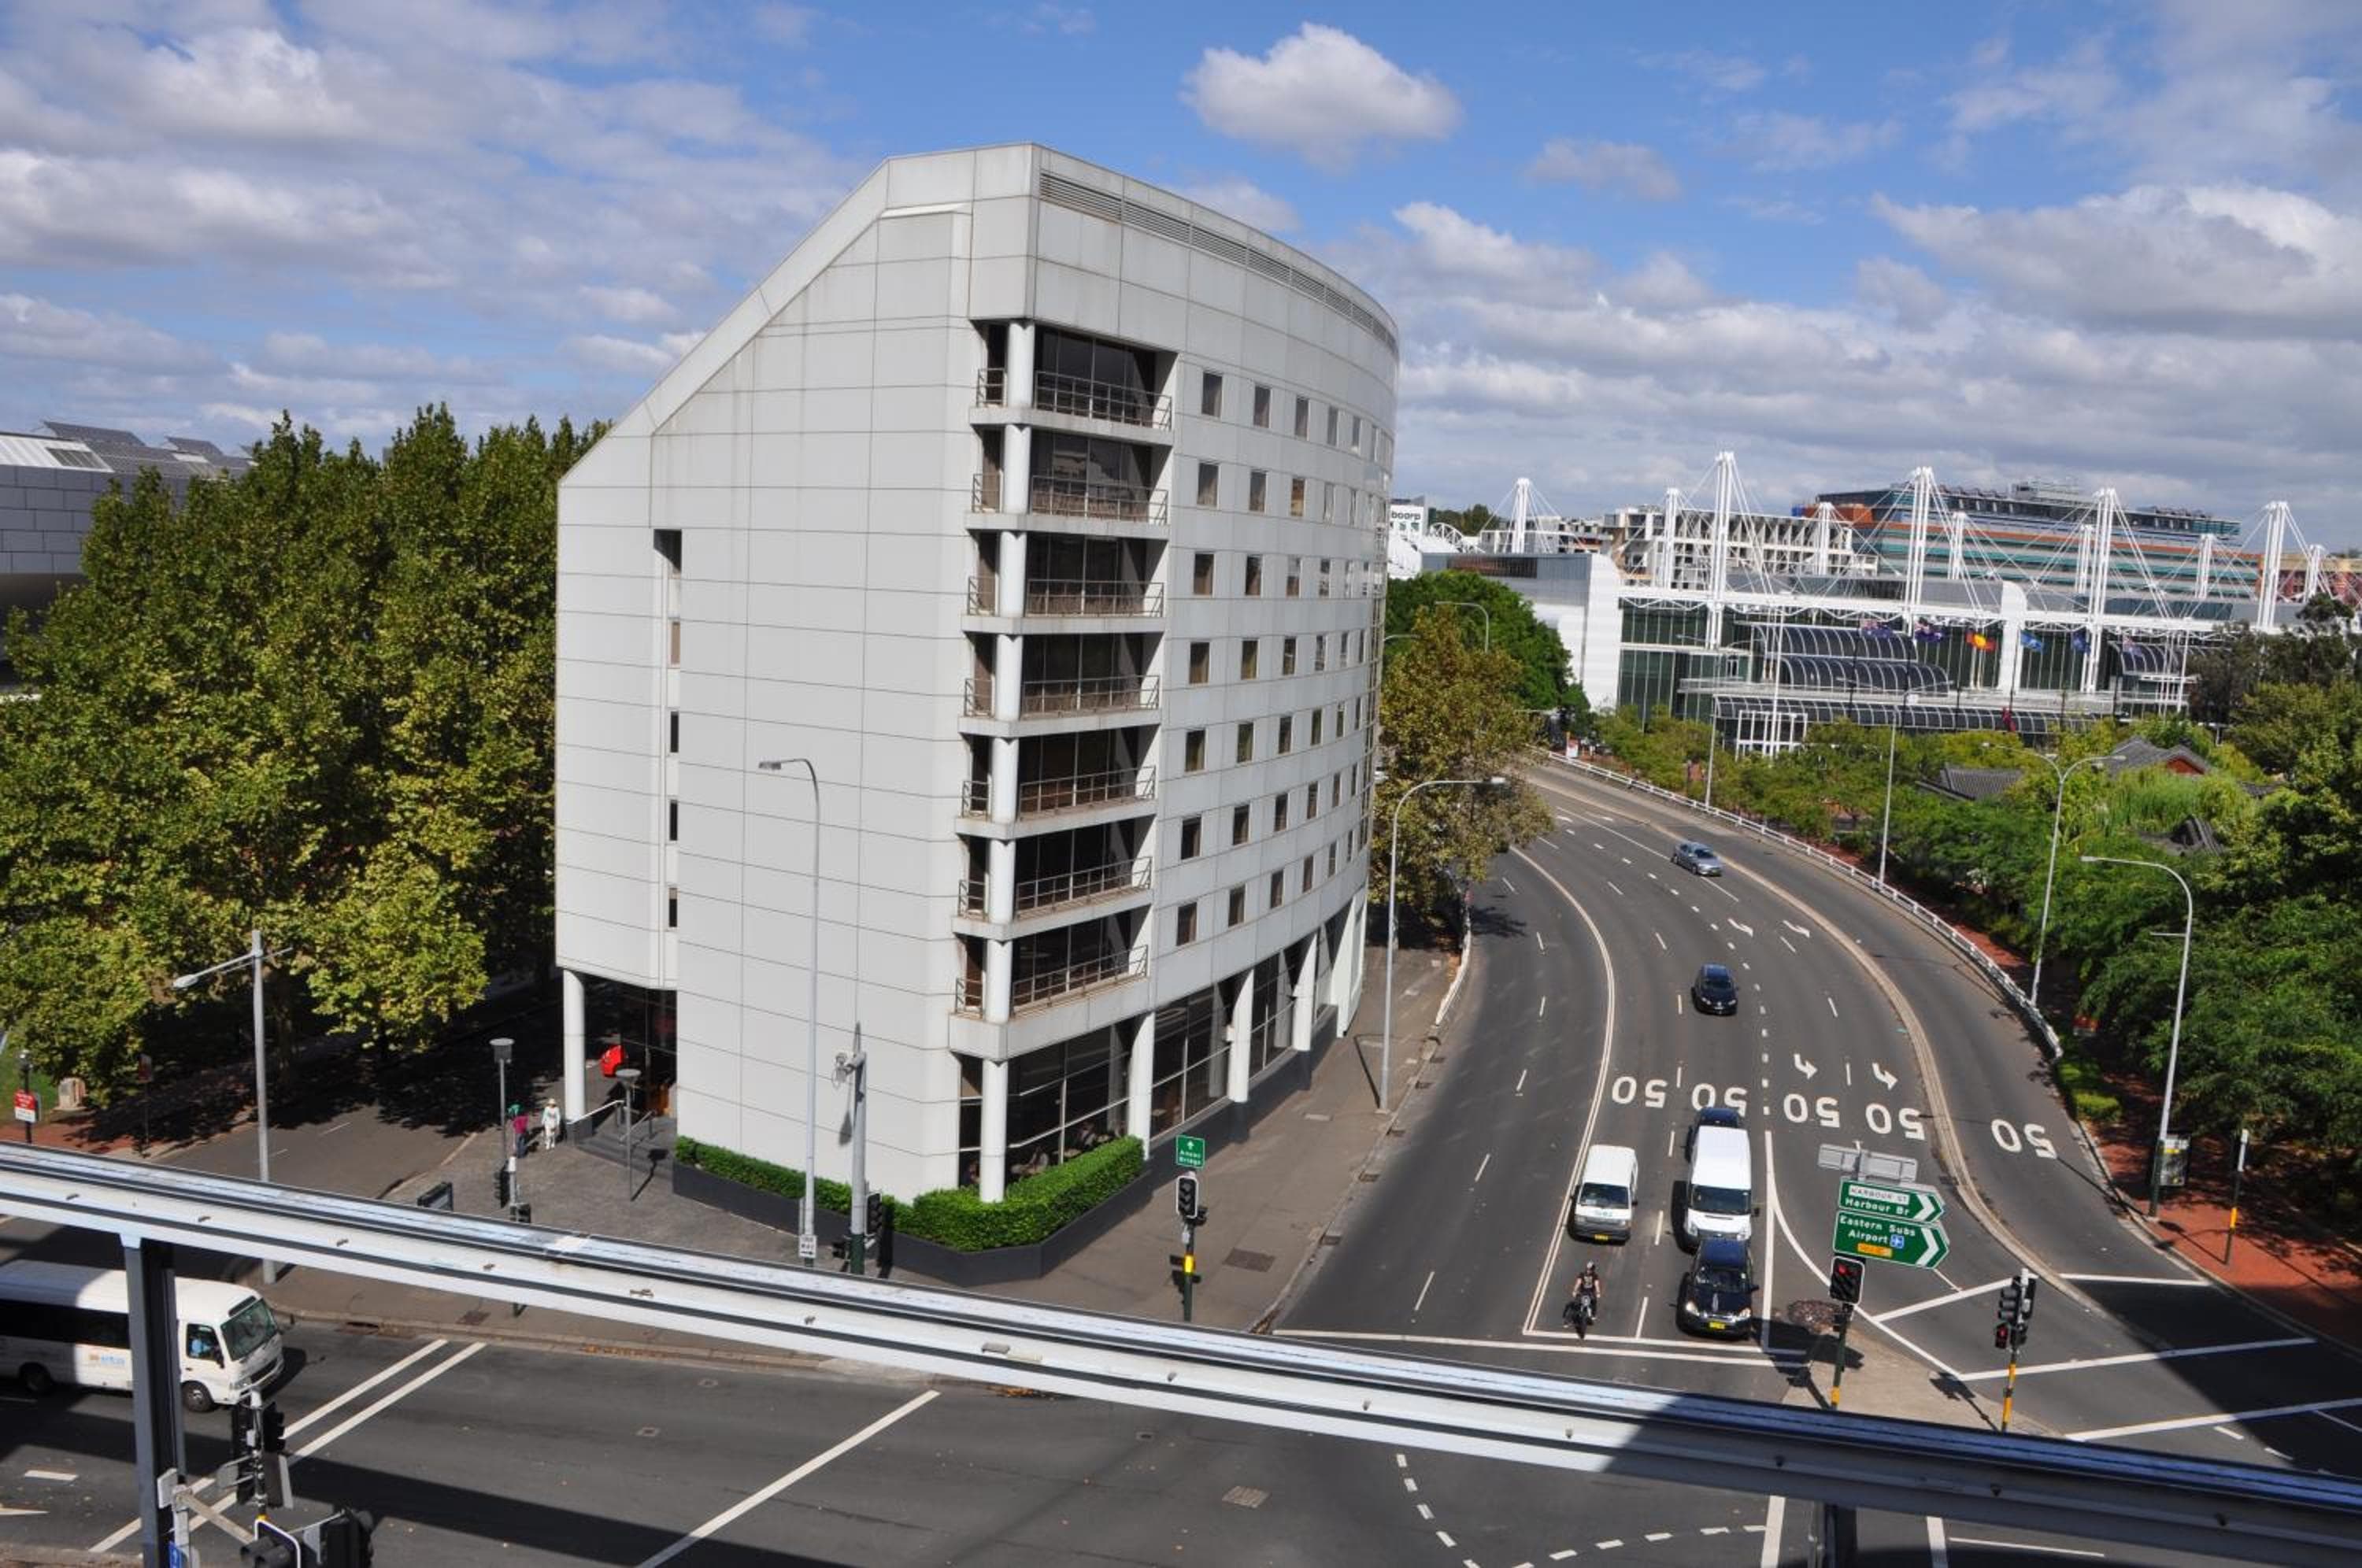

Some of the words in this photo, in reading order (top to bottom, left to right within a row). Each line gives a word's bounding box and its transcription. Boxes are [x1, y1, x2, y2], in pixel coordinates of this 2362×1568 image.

[1612, 1076, 1668, 1108] 50
[1691, 1083, 1748, 1117] 50
[1783, 1093, 1840, 1127] 50
[1865, 1104, 1925, 1140] 50
[1991, 1119, 2057, 1159] 50
[1845, 1197, 1890, 1211] Harbour
[1896, 1206, 1909, 1215] Br
[1839, 1215, 1883, 1230] Eastern
[1889, 1224, 1916, 1237] Subs
[1848, 1230, 1888, 1244] Airport
